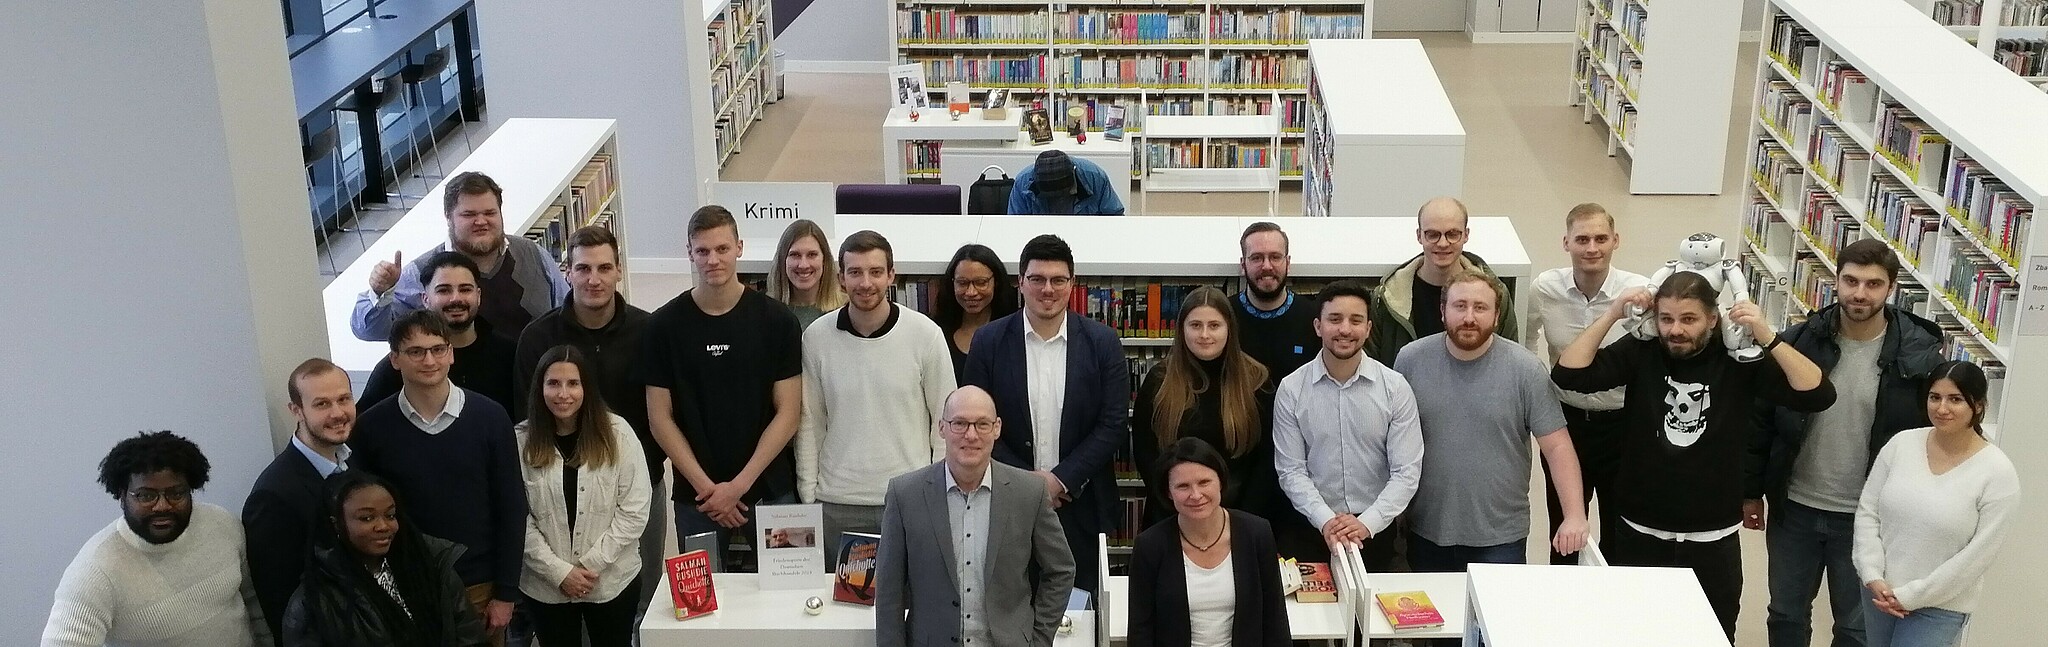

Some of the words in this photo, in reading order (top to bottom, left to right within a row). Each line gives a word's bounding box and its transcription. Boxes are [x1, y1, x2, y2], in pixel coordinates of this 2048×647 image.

[745, 202, 799, 219] Krimi
[1779, 277, 1787, 286] C
[675, 556, 707, 572] SALMAN
[839, 557, 876, 580] Quichotte
[676, 565, 709, 581] RUSHDIE
[677, 575, 711, 594] Quichotte
